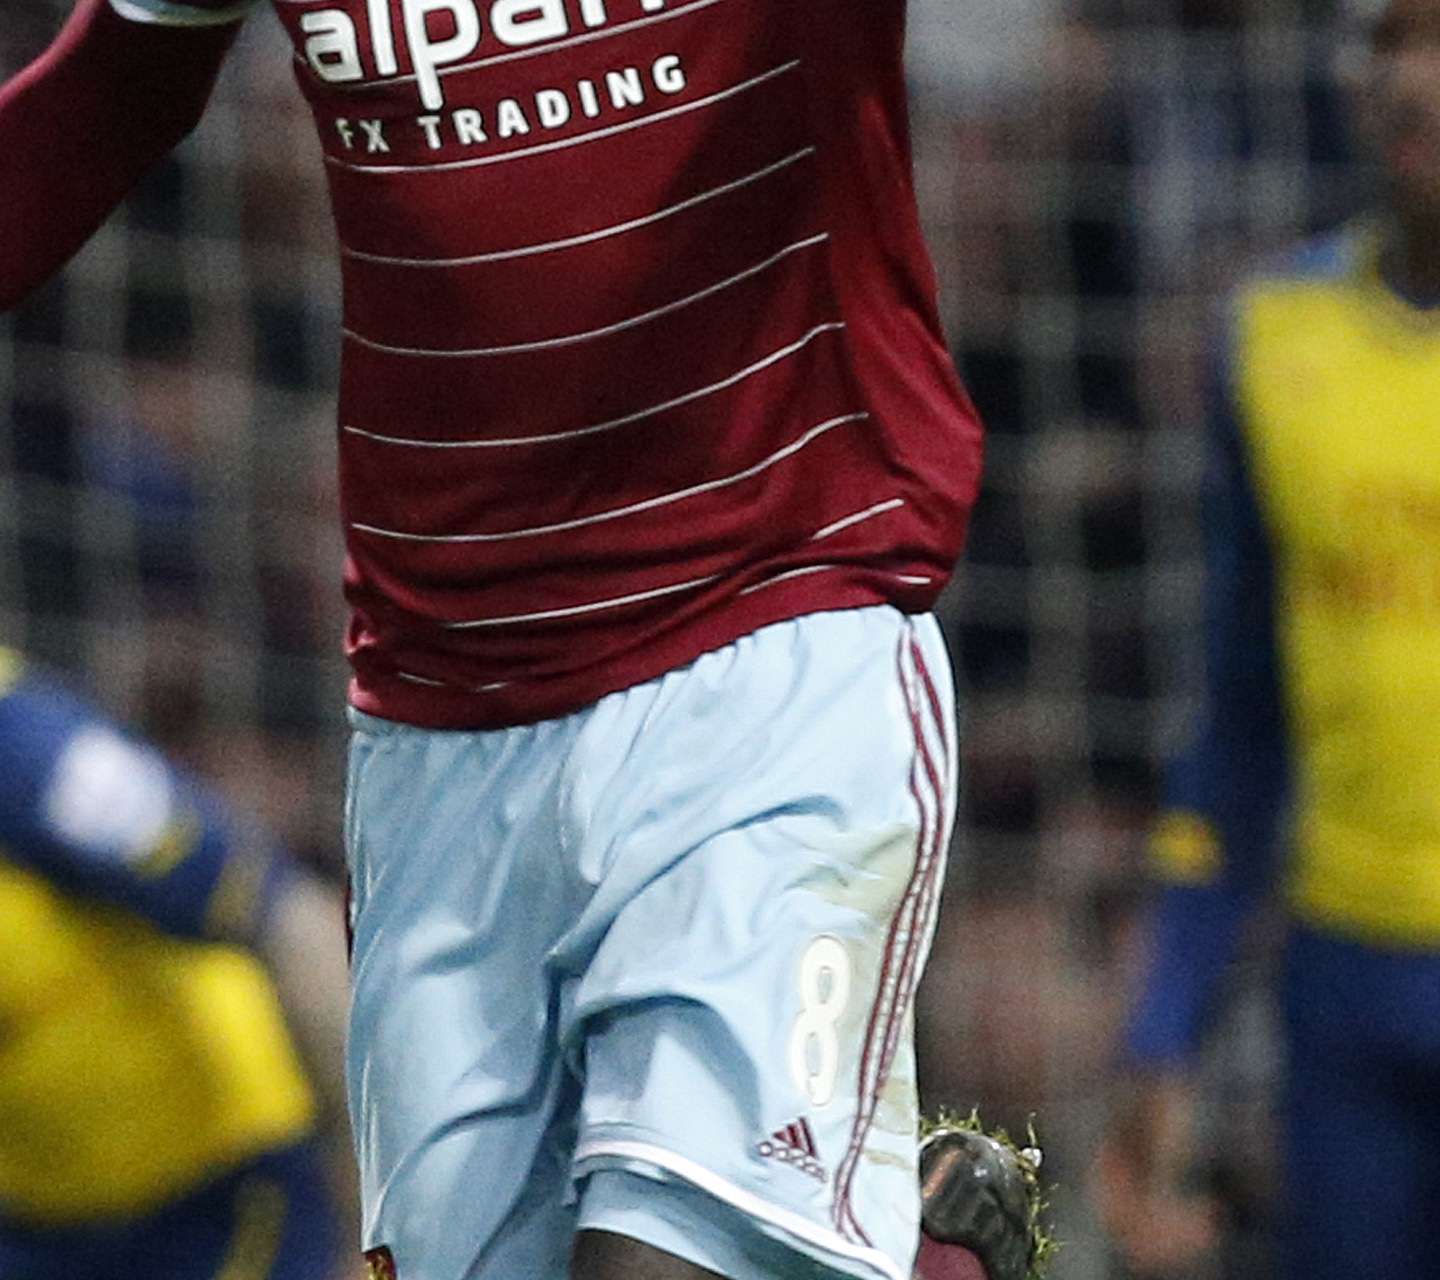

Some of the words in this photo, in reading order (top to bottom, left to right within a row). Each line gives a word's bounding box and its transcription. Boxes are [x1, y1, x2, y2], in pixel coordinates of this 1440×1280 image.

[335, 119, 390, 153] FX
[417, 55, 686, 150] TRADING
[789, 935, 850, 1107] 8
